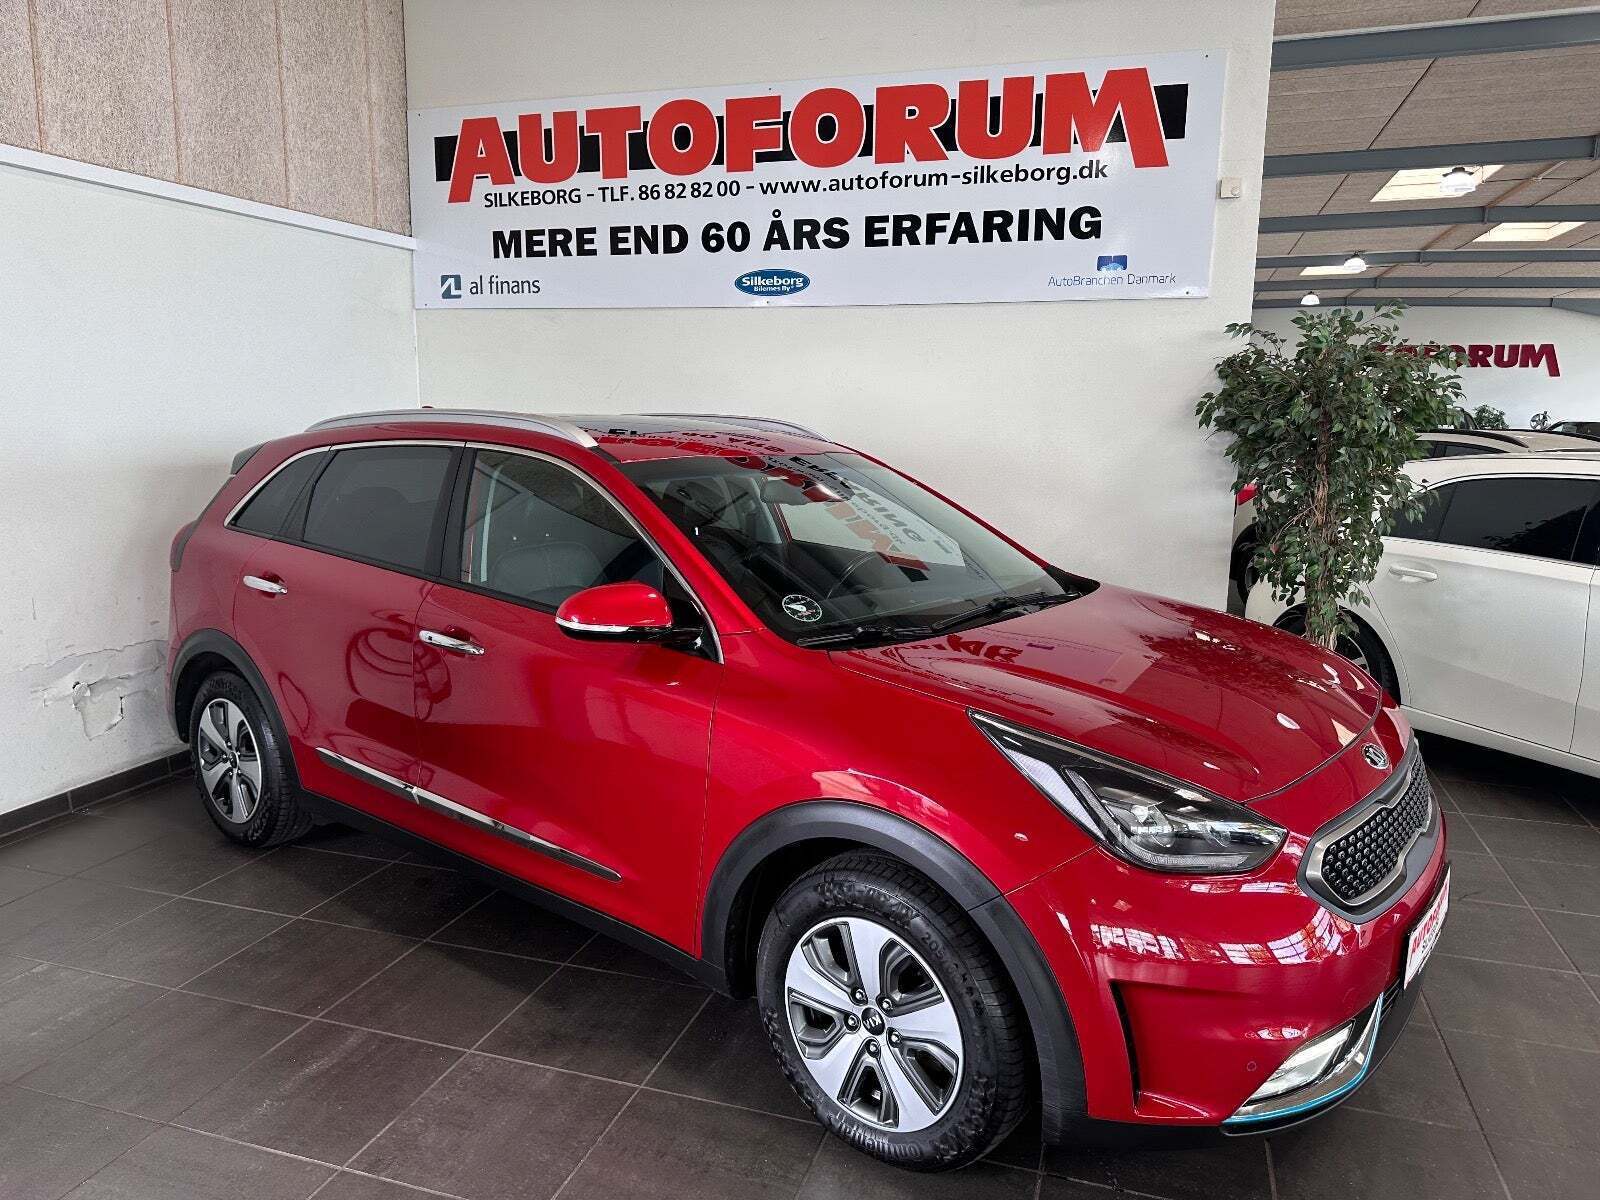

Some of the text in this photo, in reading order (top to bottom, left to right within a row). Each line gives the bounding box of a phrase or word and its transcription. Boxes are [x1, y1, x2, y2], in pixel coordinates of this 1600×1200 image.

[447, 67, 1170, 204] AUTOFORUM
[484, 187, 581, 208] SILKEBORG
[598, 186, 634, 202] TLF.
[759, 159, 1109, 195] www.autoforum-silkeborg.dk
[492, 205, 1102, 259] MERE END 60 ÅRS ERFARING
[469, 274, 541, 295] al finans
[742, 275, 804, 288] Silkeborg
[1047, 272, 1177, 288] AutoBranchen Danmark
